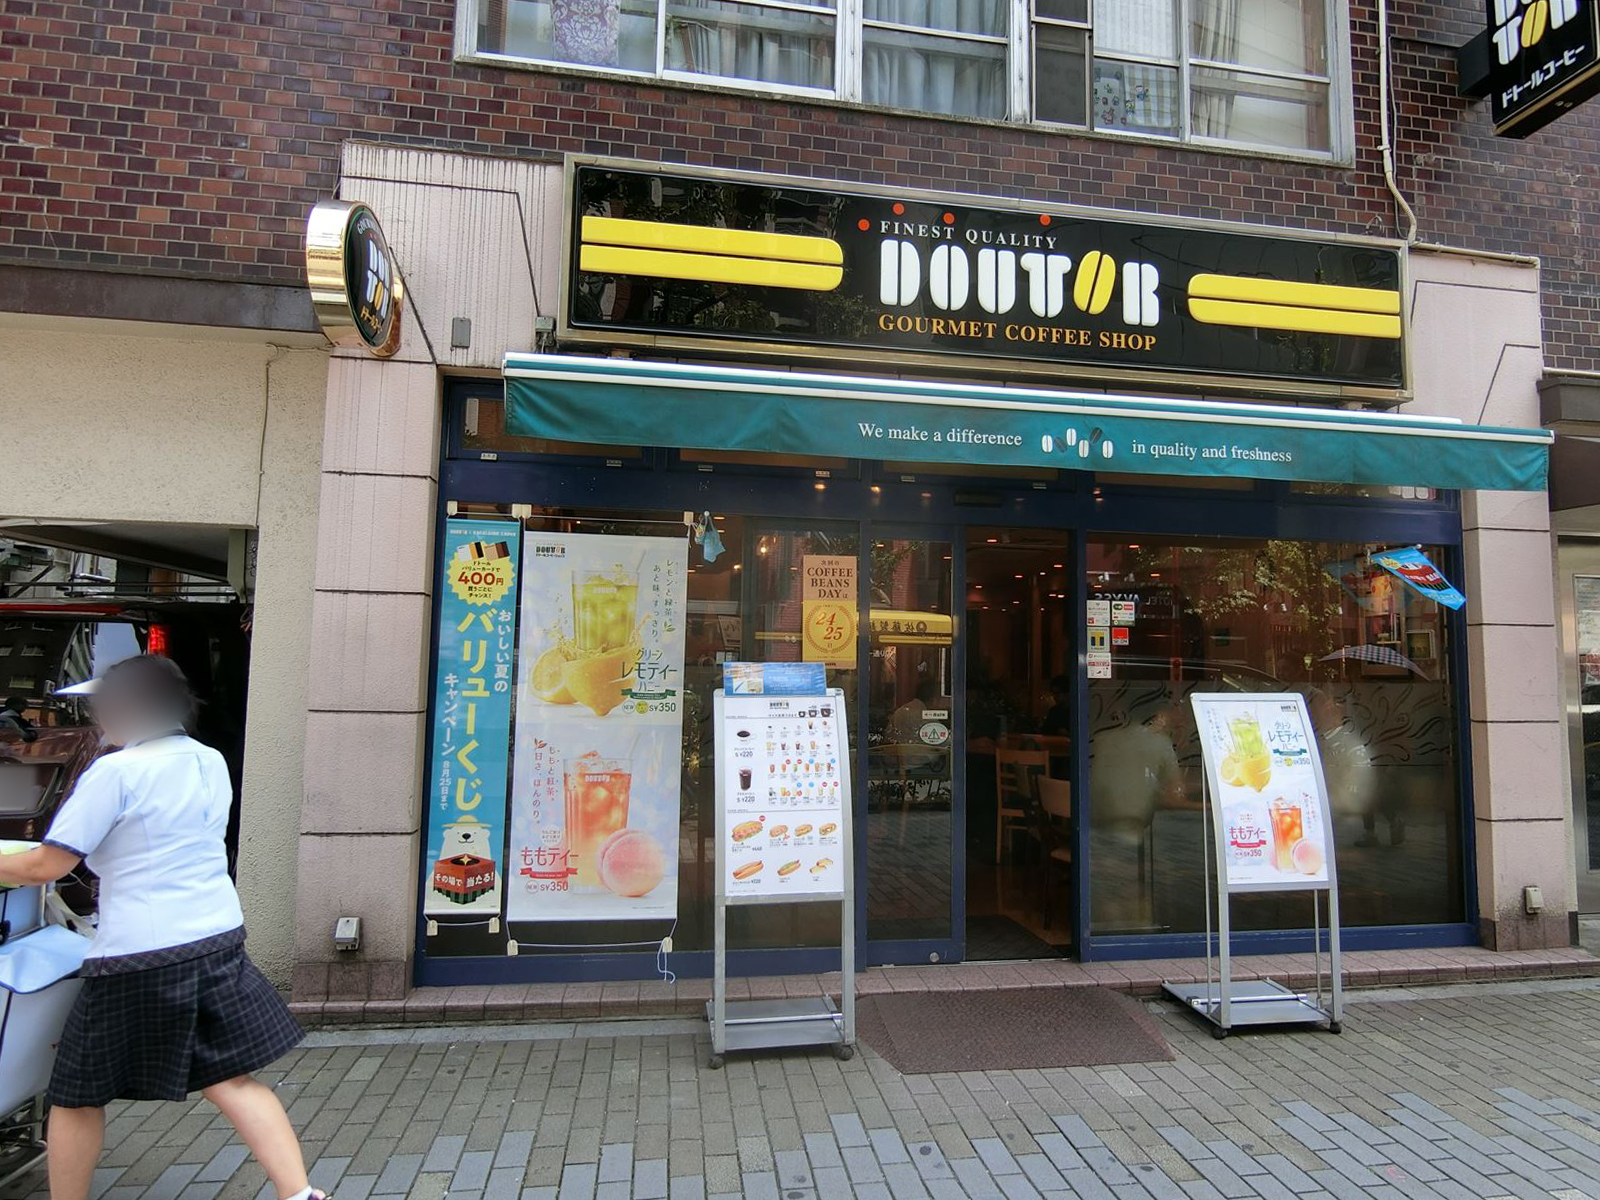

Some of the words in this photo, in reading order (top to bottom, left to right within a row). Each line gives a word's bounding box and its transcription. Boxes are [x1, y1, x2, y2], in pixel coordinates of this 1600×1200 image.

[1502, 45, 1585, 109] ドトールコーヒー
[880, 220, 954, 240] FINEST
[965, 229, 1057, 249] QUALITY
[880, 239, 1160, 327] DOUTOR
[878, 314, 997, 339] GOURMET
[1005, 324, 1092, 346] COFFEE
[1099, 331, 1157, 351] SHOP
[858, 422, 883, 439] We
[888, 425, 929, 441] make
[933, 431, 942, 442] a
[946, 427, 1023, 447] difference
[1131, 439, 1147, 455] in
[1149, 441, 1198, 461] quality
[1202, 443, 1228, 459] and
[1231, 445, 1293, 463] freshness
[458, 571, 504, 586] 400円
[807, 567, 853, 578] COFFEE
[811, 578, 850, 588] BEANS
[818, 589, 842, 598] DAY
[816, 612, 836, 626] 24
[824, 626, 843, 640] 25
[494, 609, 512, 692] おいしい夏の
[636, 647, 663, 661] グリーン
[622, 661, 678, 680] レモティー
[639, 681, 661, 692] ハニー
[442, 672, 459, 756] キャンペーン
[455, 607, 498, 811] バリューくじ
[521, 846, 579, 866] ももティー
[435, 873, 463, 887] その場で
[466, 871, 495, 888] 当たる！
